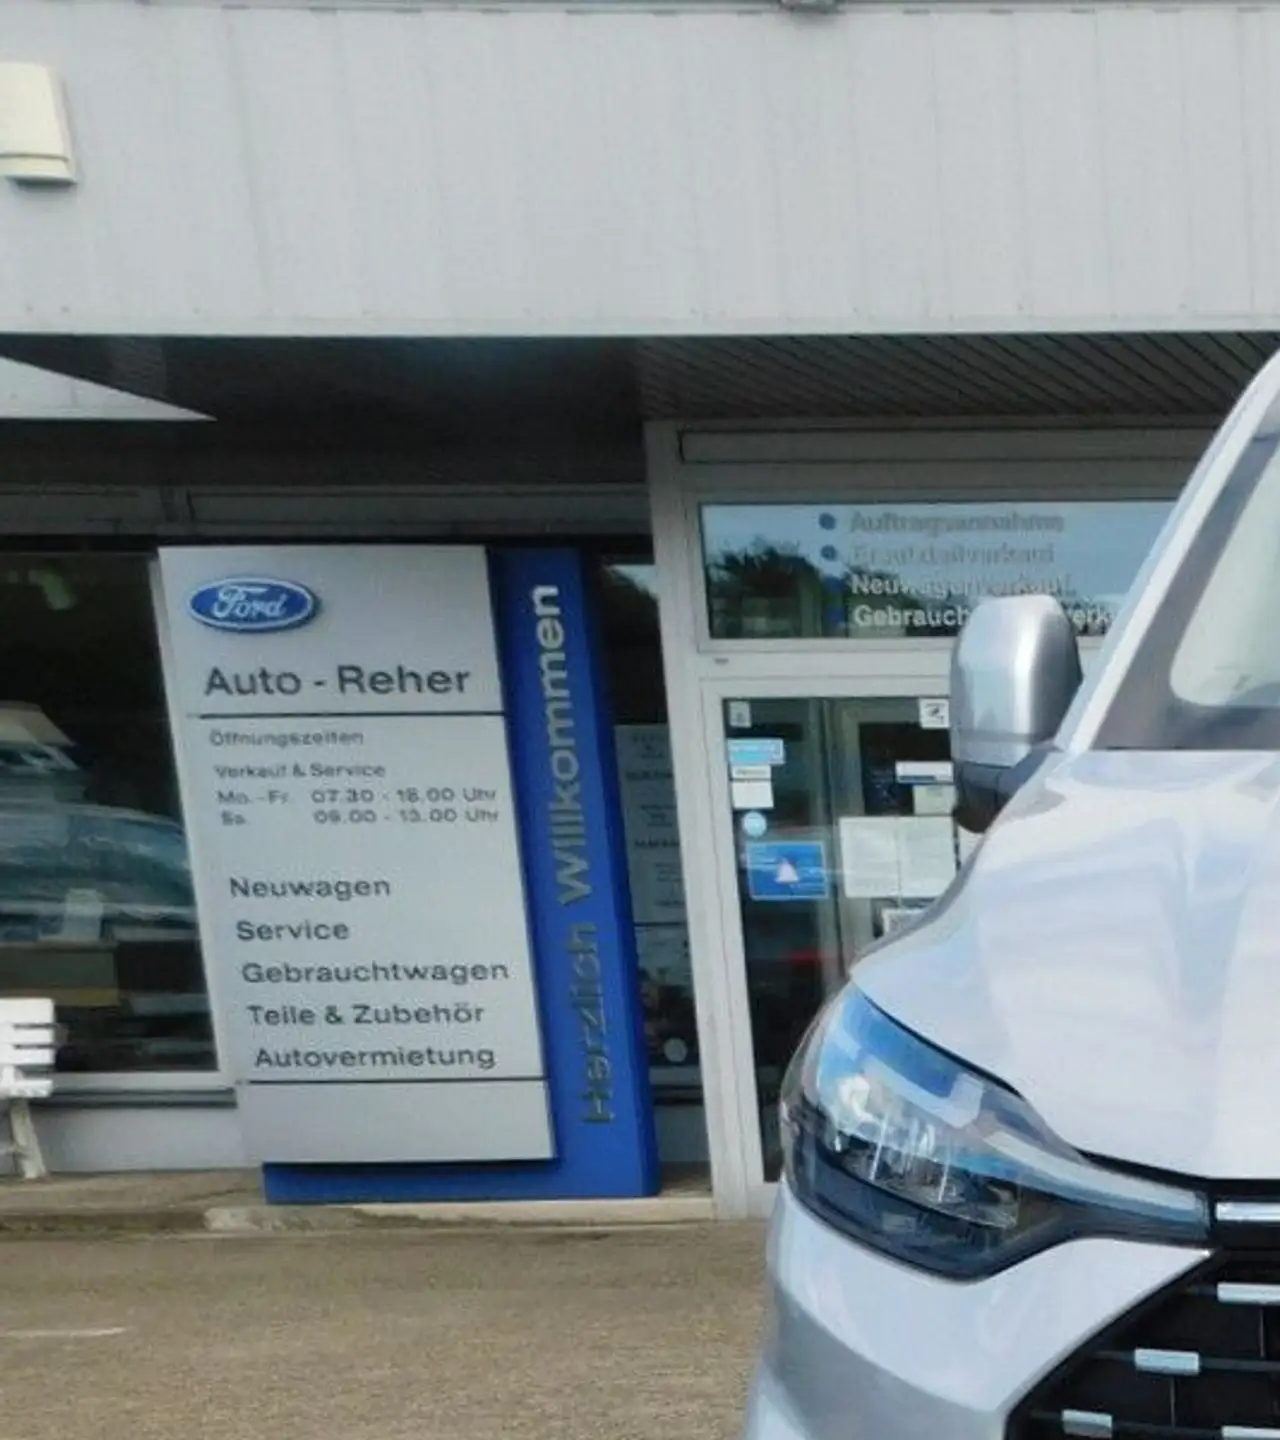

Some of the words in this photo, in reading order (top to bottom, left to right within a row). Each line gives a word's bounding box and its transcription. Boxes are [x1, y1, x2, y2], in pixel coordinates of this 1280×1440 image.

[211, 585, 288, 619] Ford
[205, 666, 302, 696] Auto
[336, 664, 471, 694] Reher
[209, 729, 365, 748] Öffnungszeiten
[531, 584, 593, 906] Willkommen
[214, 763, 287, 780] Verkauf
[292, 762, 306, 778] &
[309, 761, 386, 778] Service
[463, 786, 497, 803] Uhr
[465, 807, 500, 823] Uhr
[229, 877, 392, 901] Neuwagen
[235, 920, 350, 942] Service
[241, 961, 510, 985] Gebrauchtwagen
[246, 1004, 317, 1027] Teile
[323, 1004, 345, 1026] &
[352, 1002, 486, 1026] Zubehör
[565, 921, 614, 1124] Herzlich
[254, 1047, 498, 1071] Autovermietung
